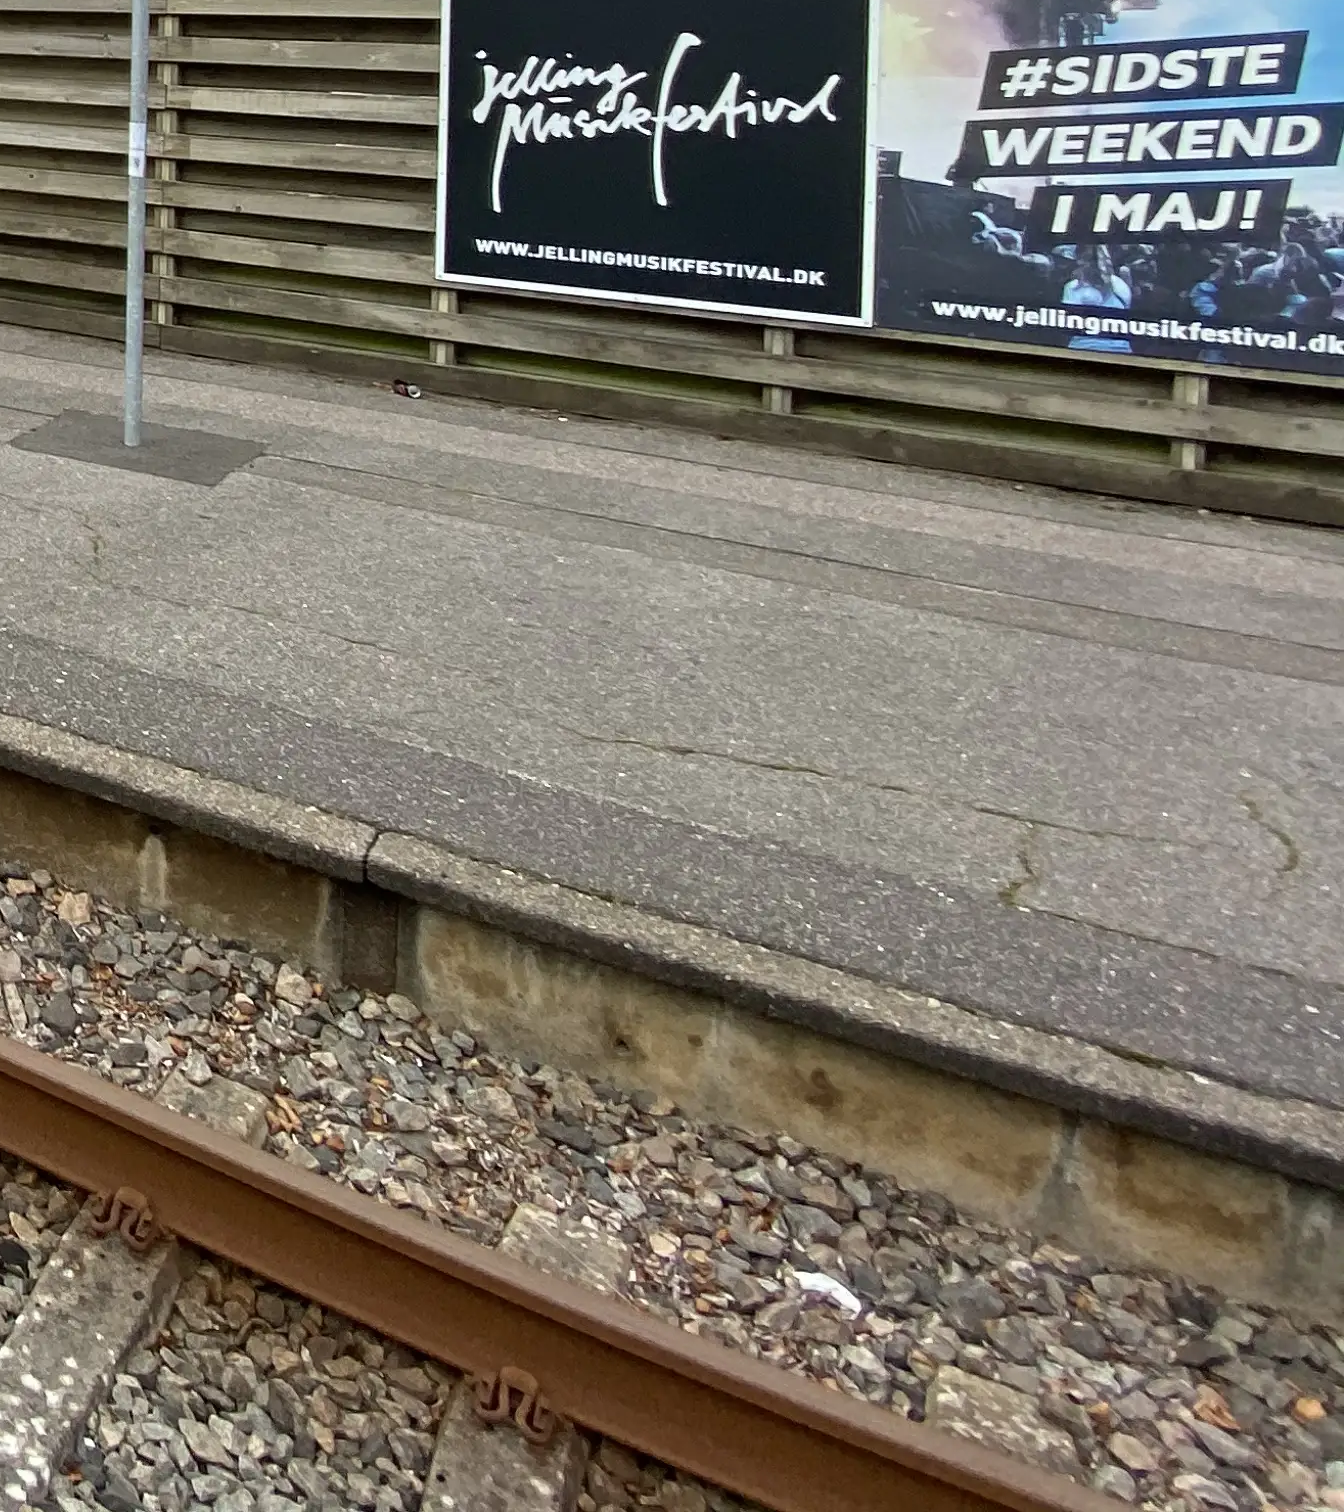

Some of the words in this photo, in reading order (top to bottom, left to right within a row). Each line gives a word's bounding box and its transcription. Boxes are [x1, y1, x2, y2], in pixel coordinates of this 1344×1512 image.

[1000, 43, 1286, 99] #SIDSTE
[982, 114, 1322, 167] WEEKEND
[1050, 194, 1075, 233] I
[1093, 190, 1264, 233] MAJ!
[475, 238, 826, 287] WWW.JELLINGMUSIKFESTIVAL.DK
[932, 299, 1344, 356] www.jellingmusikfestival.dk
